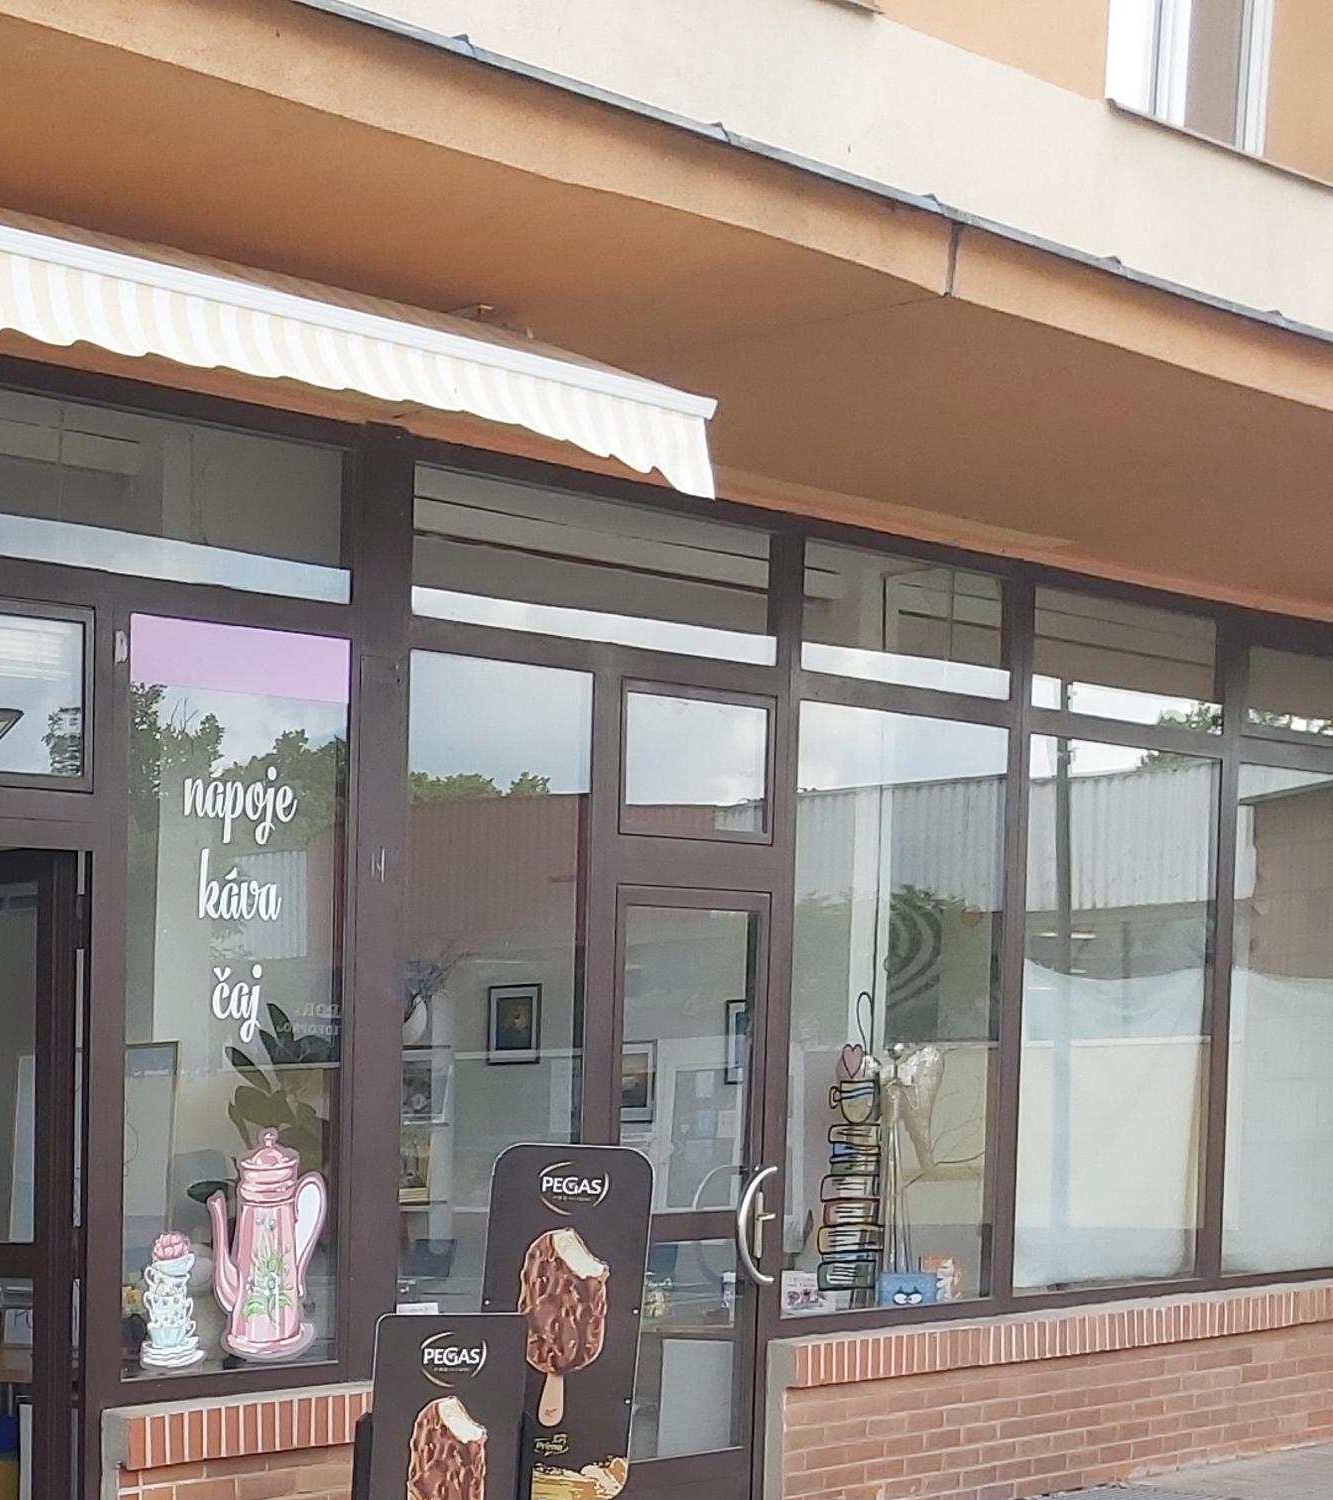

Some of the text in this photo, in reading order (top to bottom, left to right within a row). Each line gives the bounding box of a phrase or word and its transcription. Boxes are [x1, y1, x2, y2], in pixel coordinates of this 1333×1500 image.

[183, 766, 298, 844] nápoje
[197, 848, 282, 921] káva
[211, 964, 263, 1043] čaj
[541, 1176, 603, 1195] PEGAS
[422, 1347, 482, 1366] PEGAS
